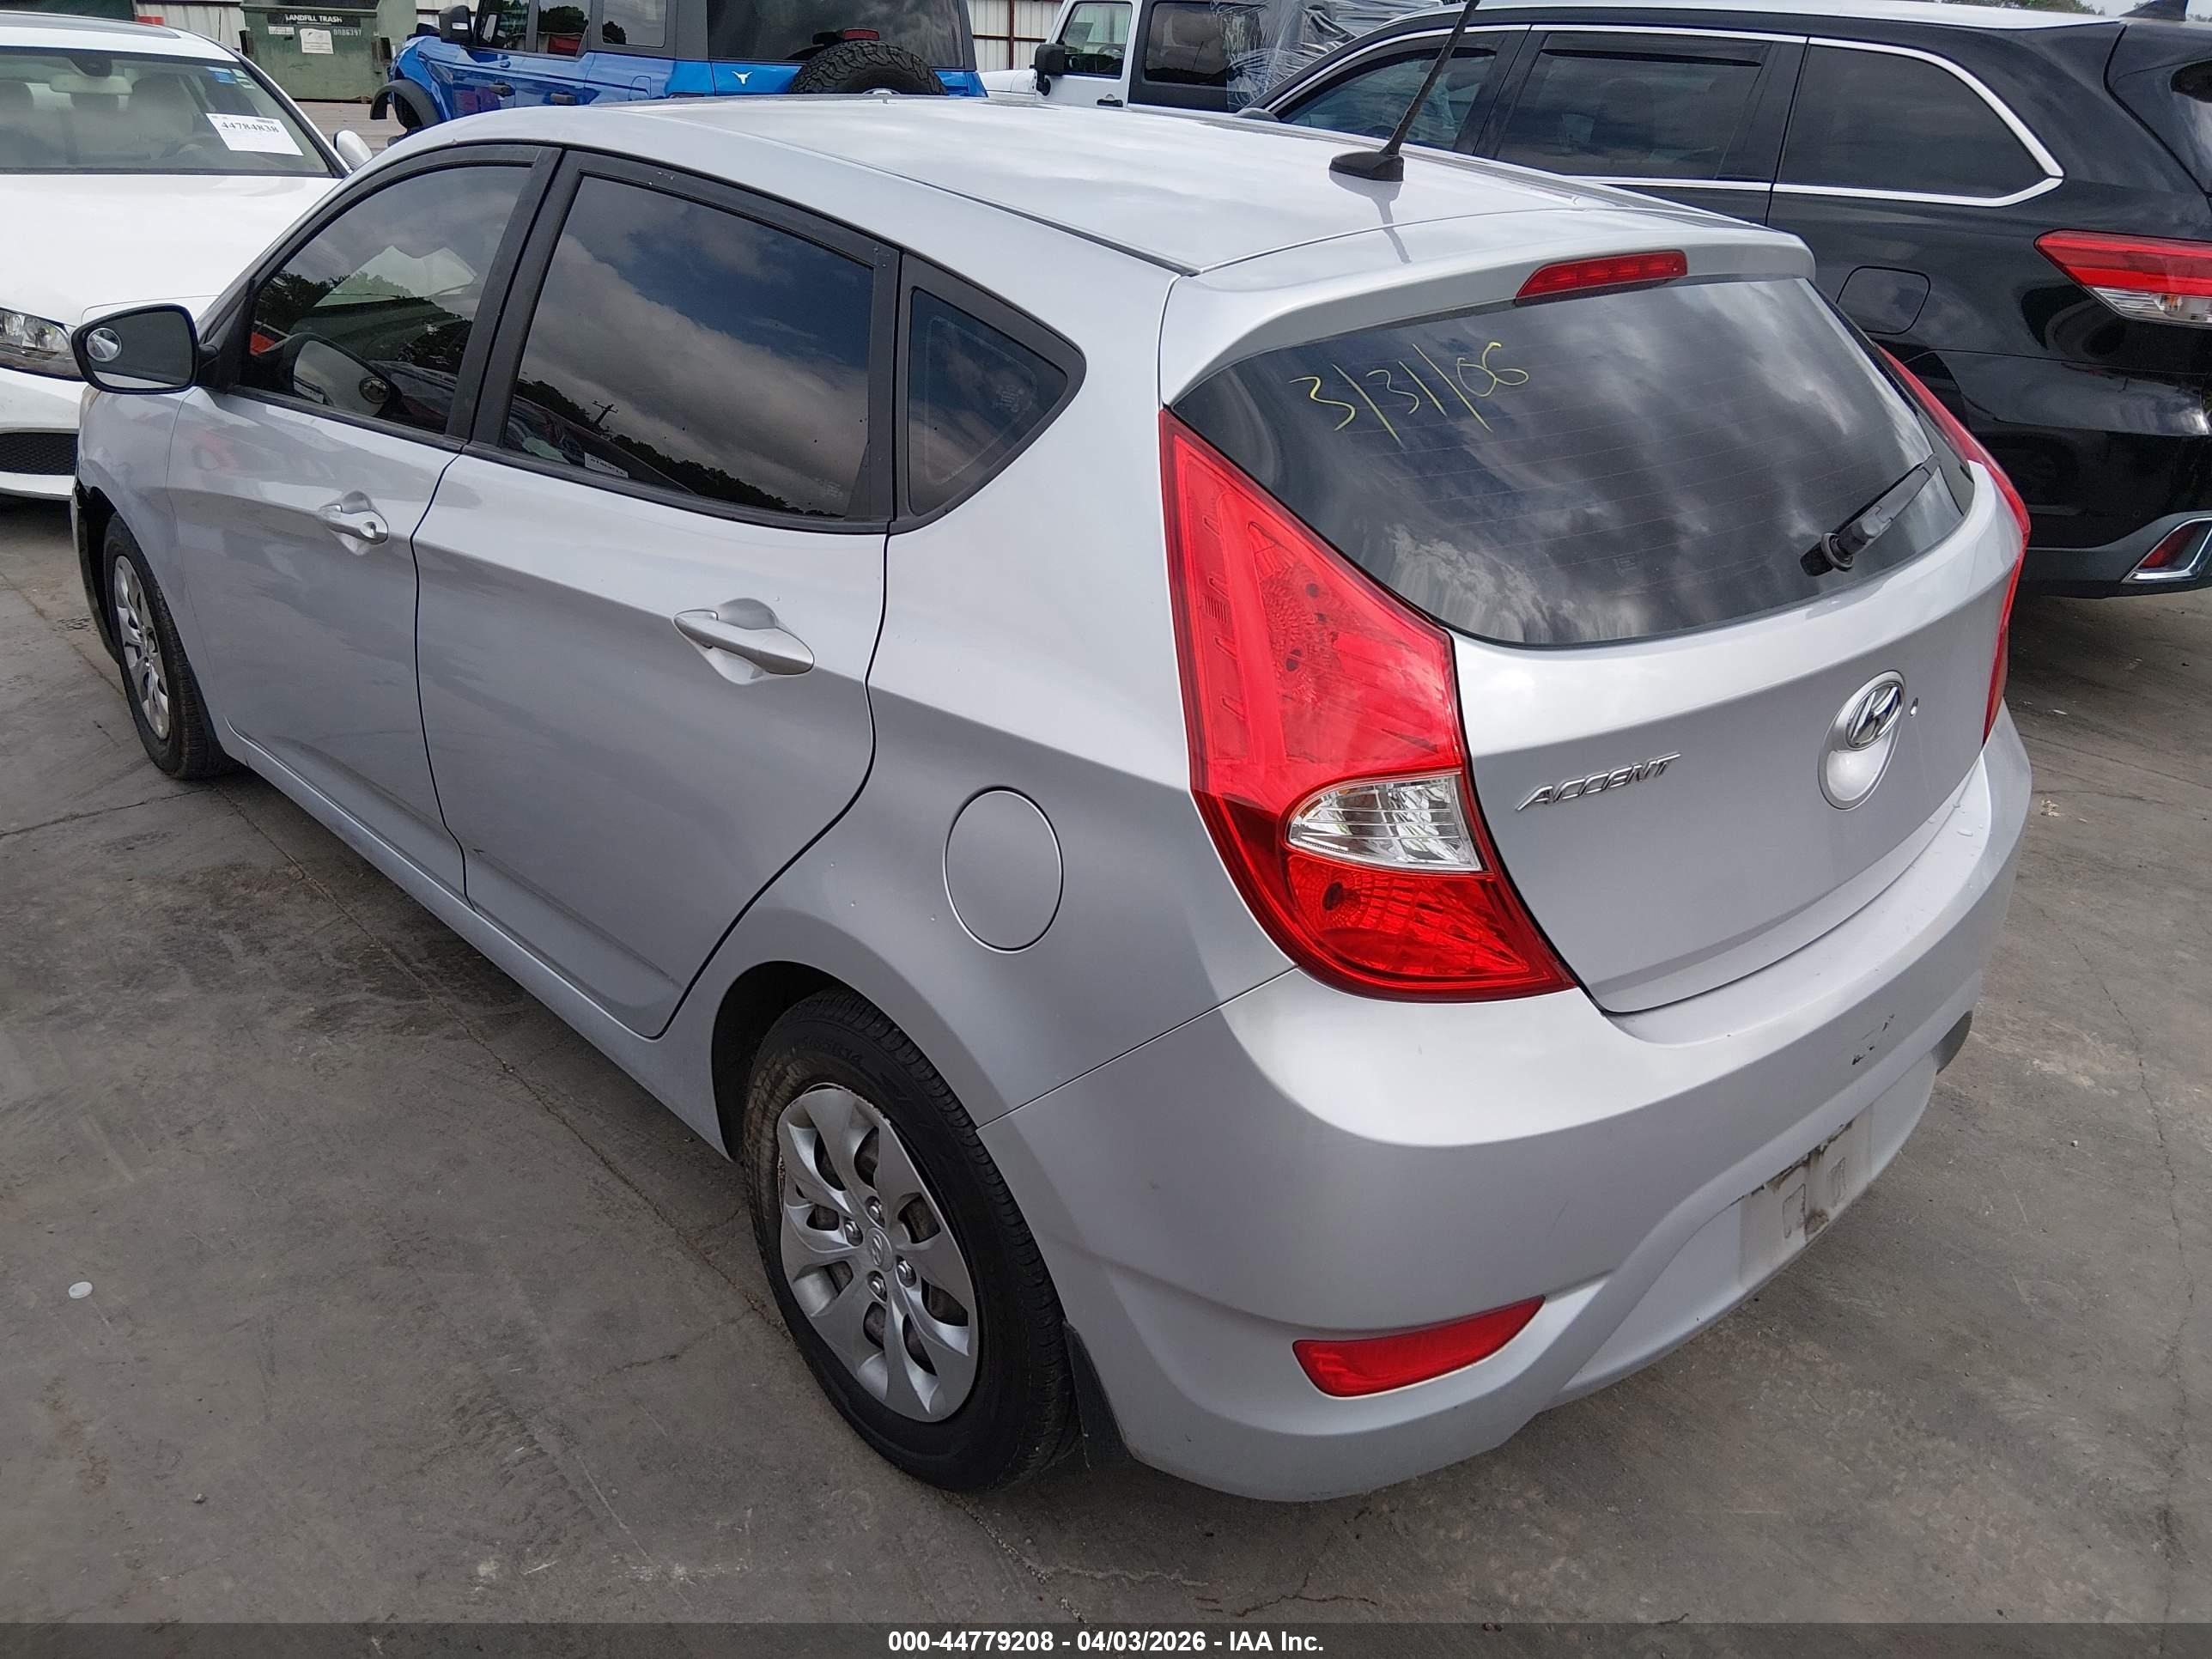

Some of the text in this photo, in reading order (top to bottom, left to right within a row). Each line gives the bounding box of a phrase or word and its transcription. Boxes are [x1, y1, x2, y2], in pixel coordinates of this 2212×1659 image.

[285, 13, 343, 23] LANDFILL TRASH
[221, 121, 280, 133] 44784838
[1515, 751, 1682, 811] ACCENT
